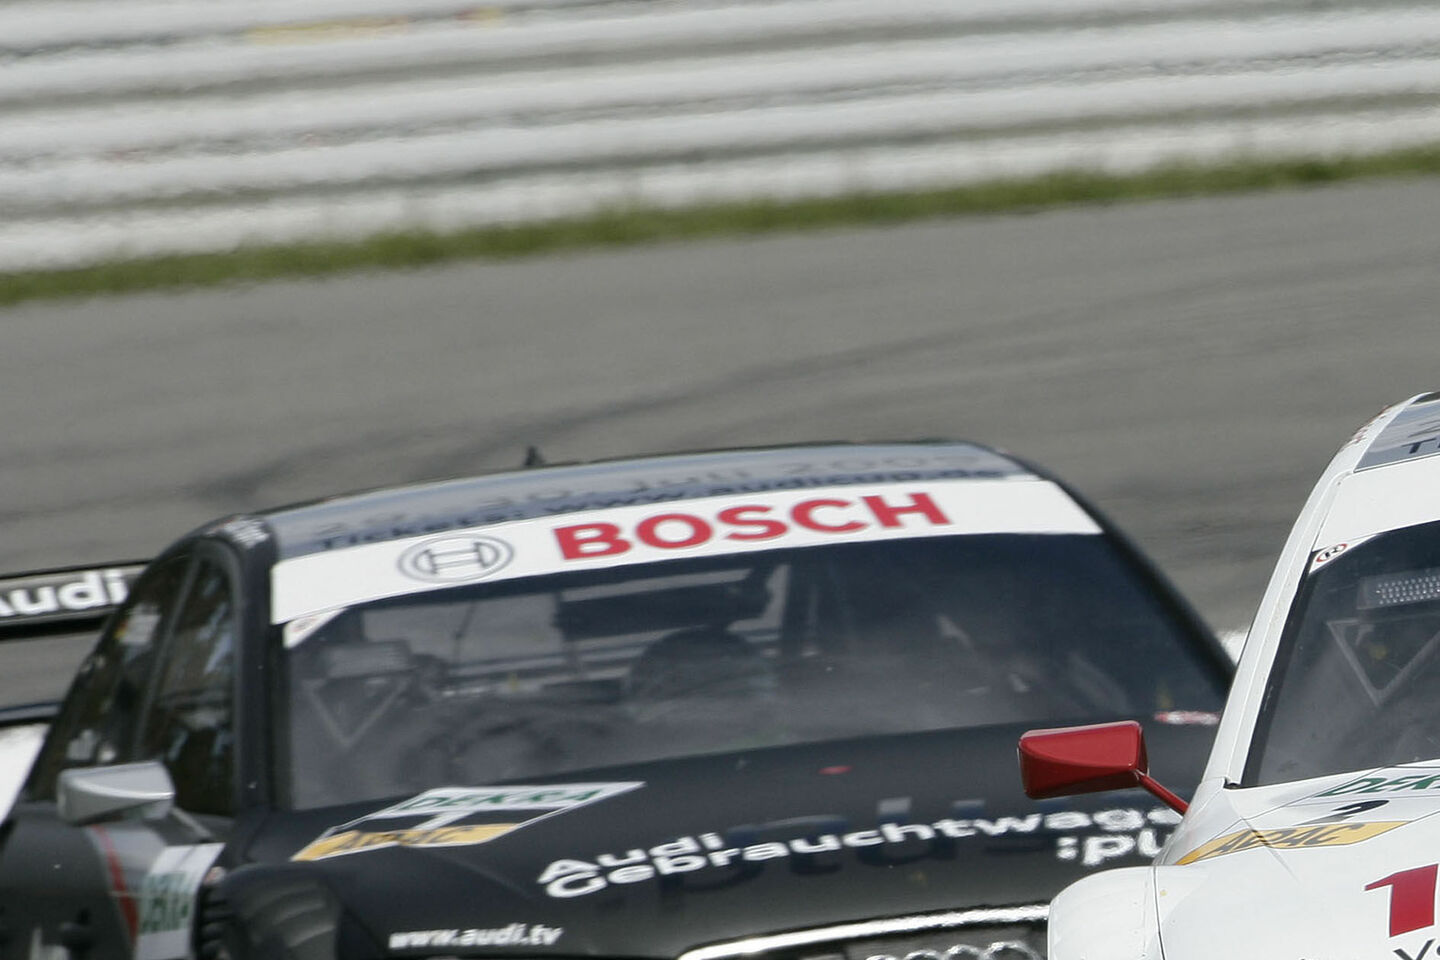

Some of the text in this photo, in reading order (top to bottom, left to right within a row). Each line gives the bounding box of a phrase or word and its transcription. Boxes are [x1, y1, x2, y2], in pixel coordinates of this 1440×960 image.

[553, 491, 952, 561] BOSCH
[536, 832, 725, 885] Audi
[545, 807, 1184, 899] Gebrauchtwage
[1207, 823, 1367, 857] ADAC
[387, 922, 565, 950] www.audi.tv
